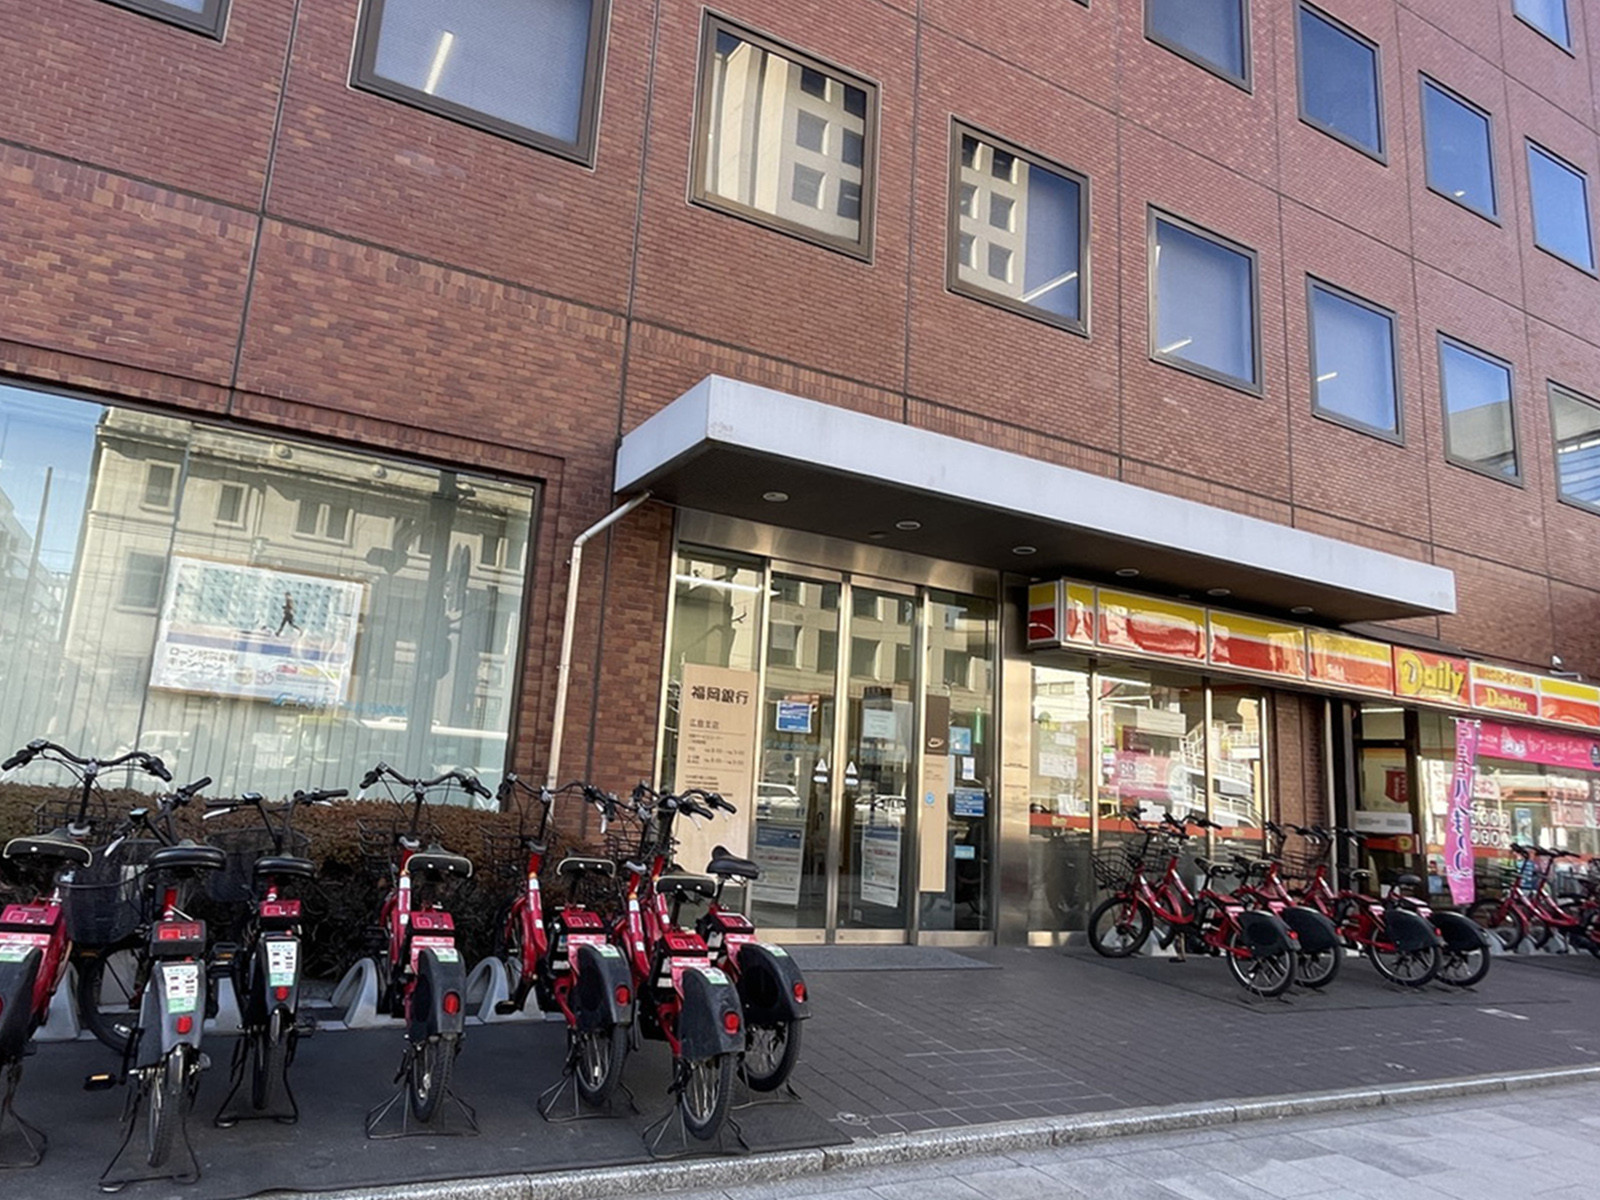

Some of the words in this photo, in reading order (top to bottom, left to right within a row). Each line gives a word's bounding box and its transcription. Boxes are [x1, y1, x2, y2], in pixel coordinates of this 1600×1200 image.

[1397, 651, 1466, 700] Daily
[691, 685, 749, 706] 福岡銀行
